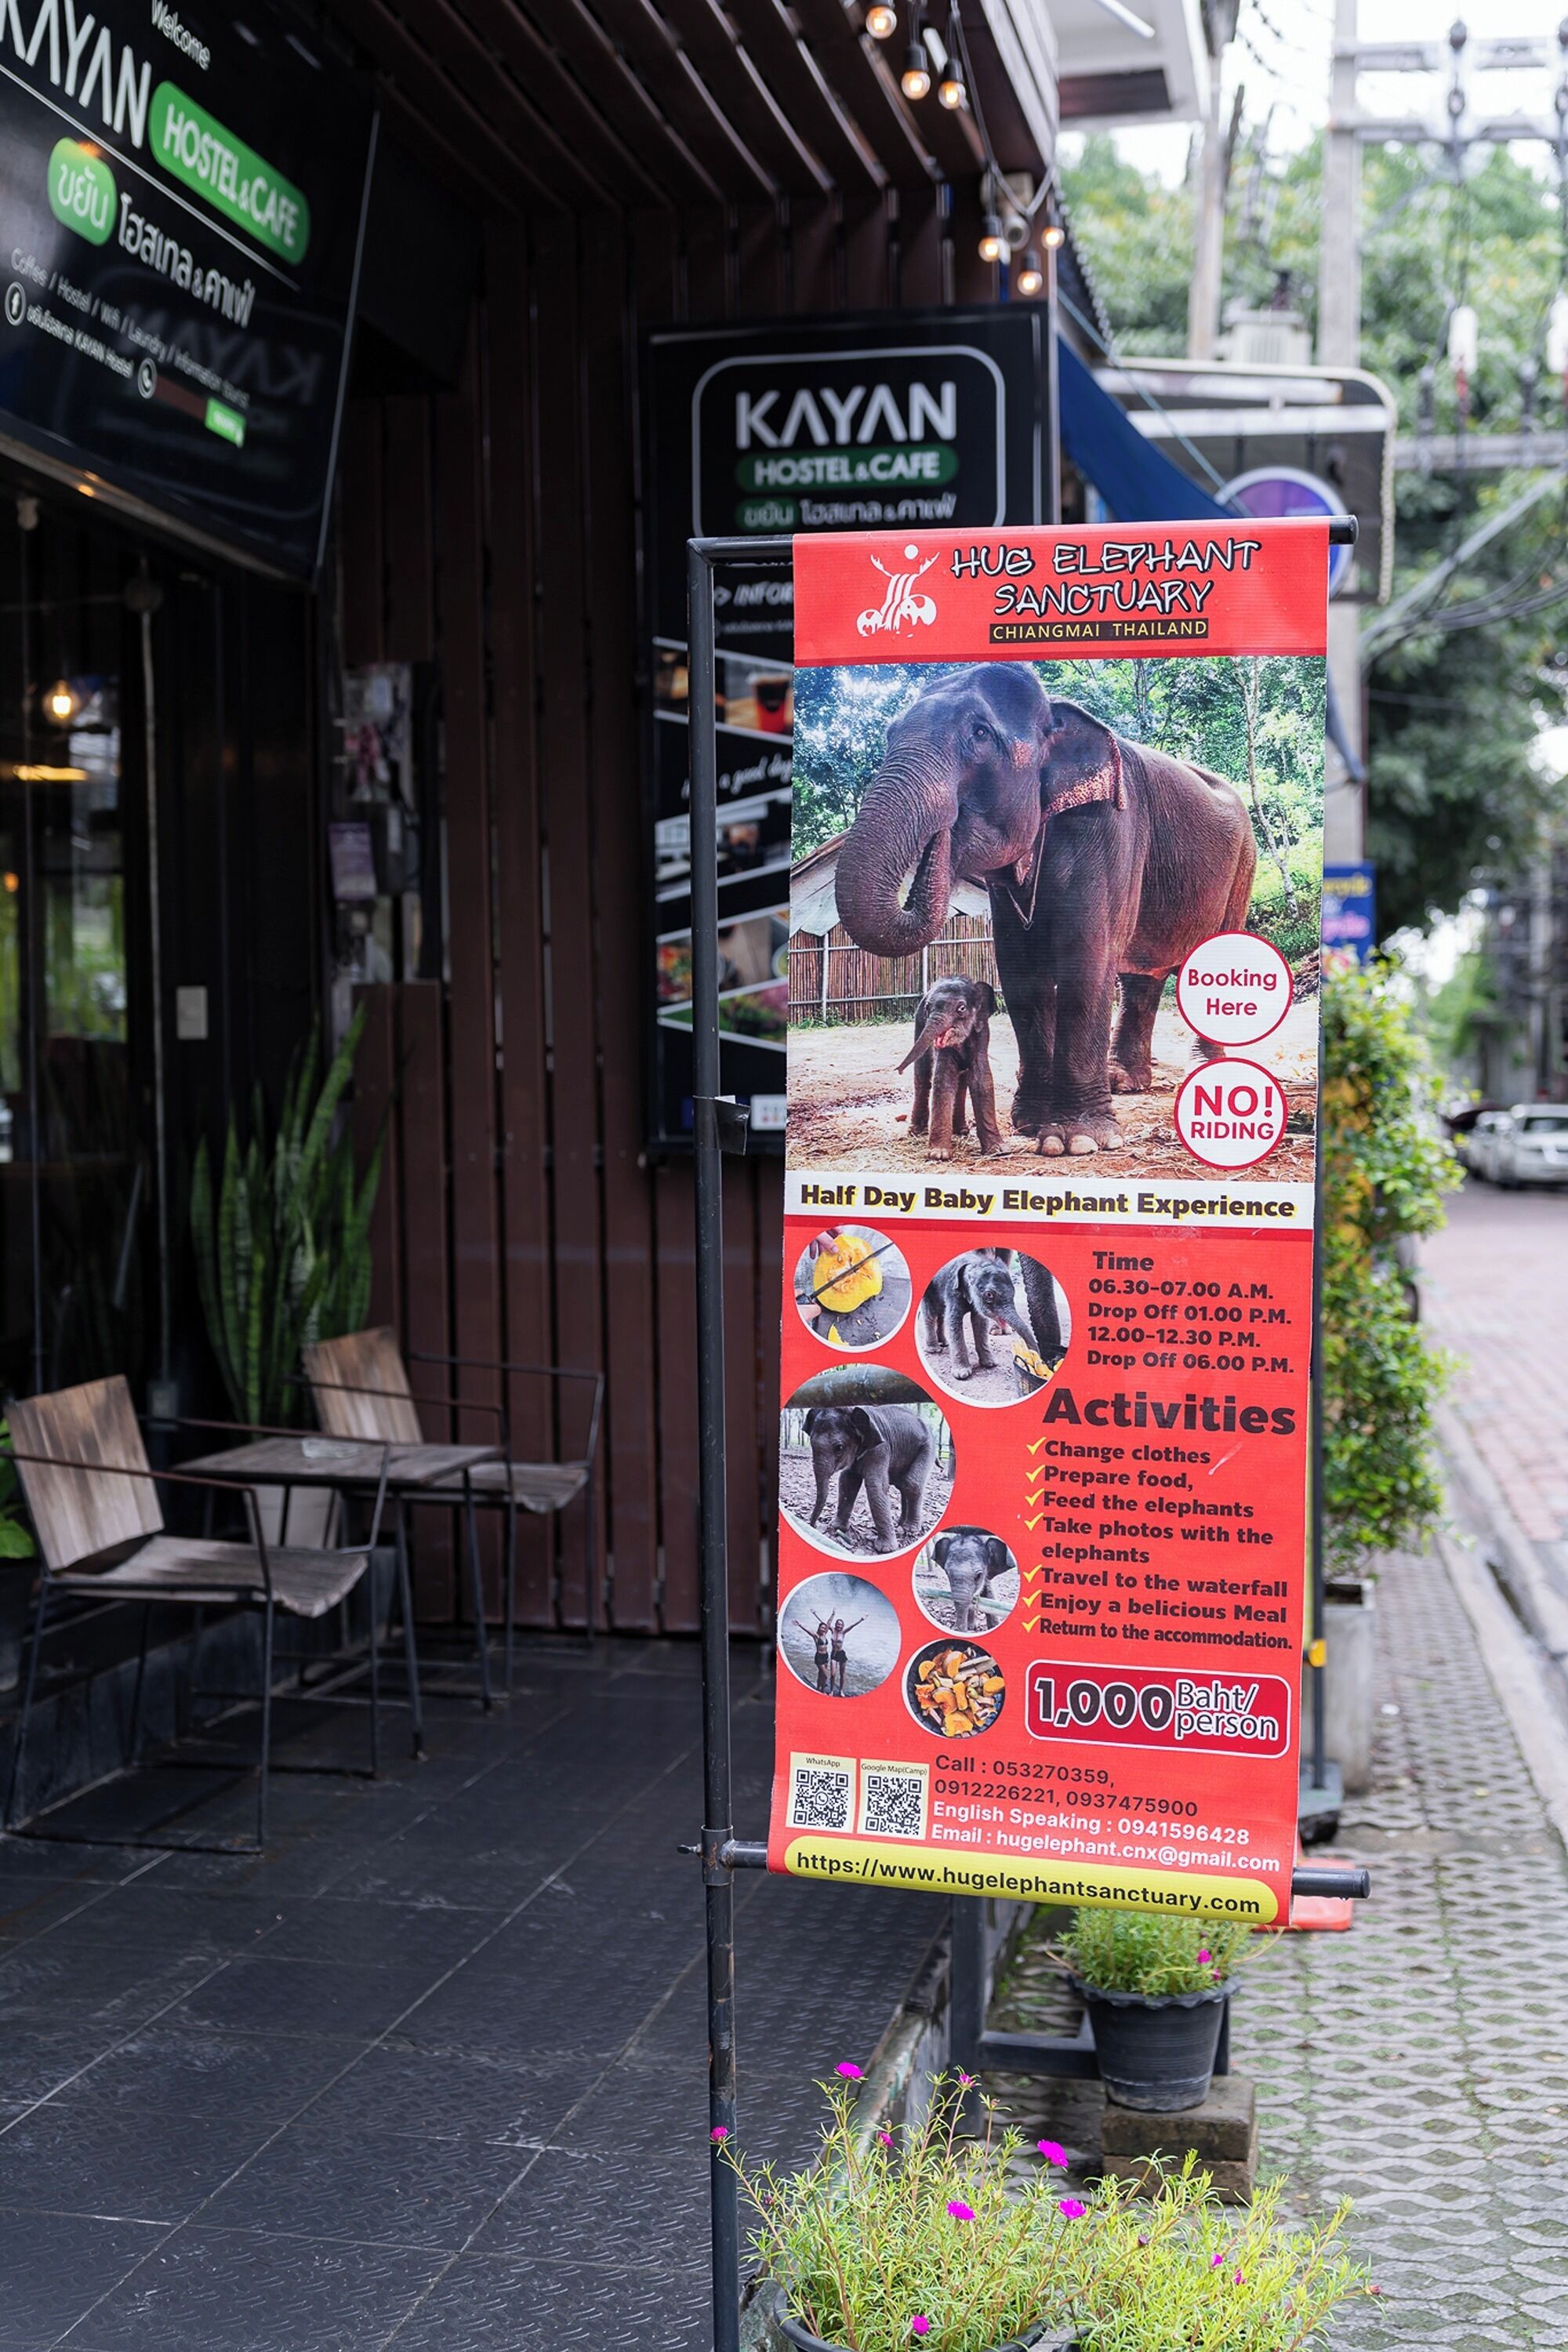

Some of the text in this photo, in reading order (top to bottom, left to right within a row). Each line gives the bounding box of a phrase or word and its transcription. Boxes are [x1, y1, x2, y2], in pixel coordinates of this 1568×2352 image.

[151, 0, 210, 71] Welcome
[58, 163, 110, 230] ขยัน
[11, 248, 48, 288] Coffee
[57, 275, 93, 313] Hostel
[736, 381, 956, 449] KAYAN
[949, 538, 1261, 578] HUG ELEPHANT
[993, 579, 1214, 617] SANCTUARY
[993, 619, 1208, 641] CHIANGMAI THAILAND
[1188, 969, 1277, 991] Booking
[1206, 998, 1258, 1016] Here
[1194, 1085, 1273, 1117] NO!
[1190, 1121, 1274, 1139] RIDING
[801, 1184, 1295, 1219] Half Day Baby Elephant Experience
[1092, 1251, 1155, 1271] Time
[1088, 1279, 1274, 1299] 06.30-07.00 A.M.
[1088, 1302, 1292, 1324] Drop Off 01.00 P.M.
[1087, 1327, 1261, 1347] 12.00-12.30 P.M.
[1087, 1350, 1294, 1373] Drop Off 06.00 P.M.
[1042, 1388, 1296, 1436] Activities
[1045, 1440, 1210, 1464] Change clothes
[1044, 1465, 1194, 1491] Prepare food,
[1044, 1491, 1254, 1519] Feed the elephants
[1043, 1516, 1274, 1544] Take photos with the
[1042, 1543, 1150, 1563] elephants
[1041, 1567, 1288, 1598] Travel to the waterfall
[1040, 1592, 1102, 1615] Enjoy
[1108, 1599, 1121, 1613] a
[1233, 1605, 1287, 1623] Meal
[1040, 1617, 1293, 1650] Return to the accommodation.
[1034, 1677, 1176, 1731] 1,000
[1175, 1679, 1259, 1714] Baht/
[1174, 1711, 1279, 1741] person
[806, 1756, 840, 1768] WhatsApp
[861, 1763, 927, 1777] Google Map(Camp)
[935, 1755, 975, 1773] Call
[993, 1760, 1114, 1788] 053270359,
[934, 1779, 1198, 1817] 0912226221, 0937475900
[933, 1801, 1004, 1824] English
[1009, 1807, 1102, 1834] Speaking
[1117, 1818, 1250, 1845] 0941596428
[931, 1824, 982, 1844] Email
[996, 1831, 1280, 1872] hugelephant.cnx@gmail.com
[797, 1852, 1261, 1914] https://www.hugelephantsanctuary.com
